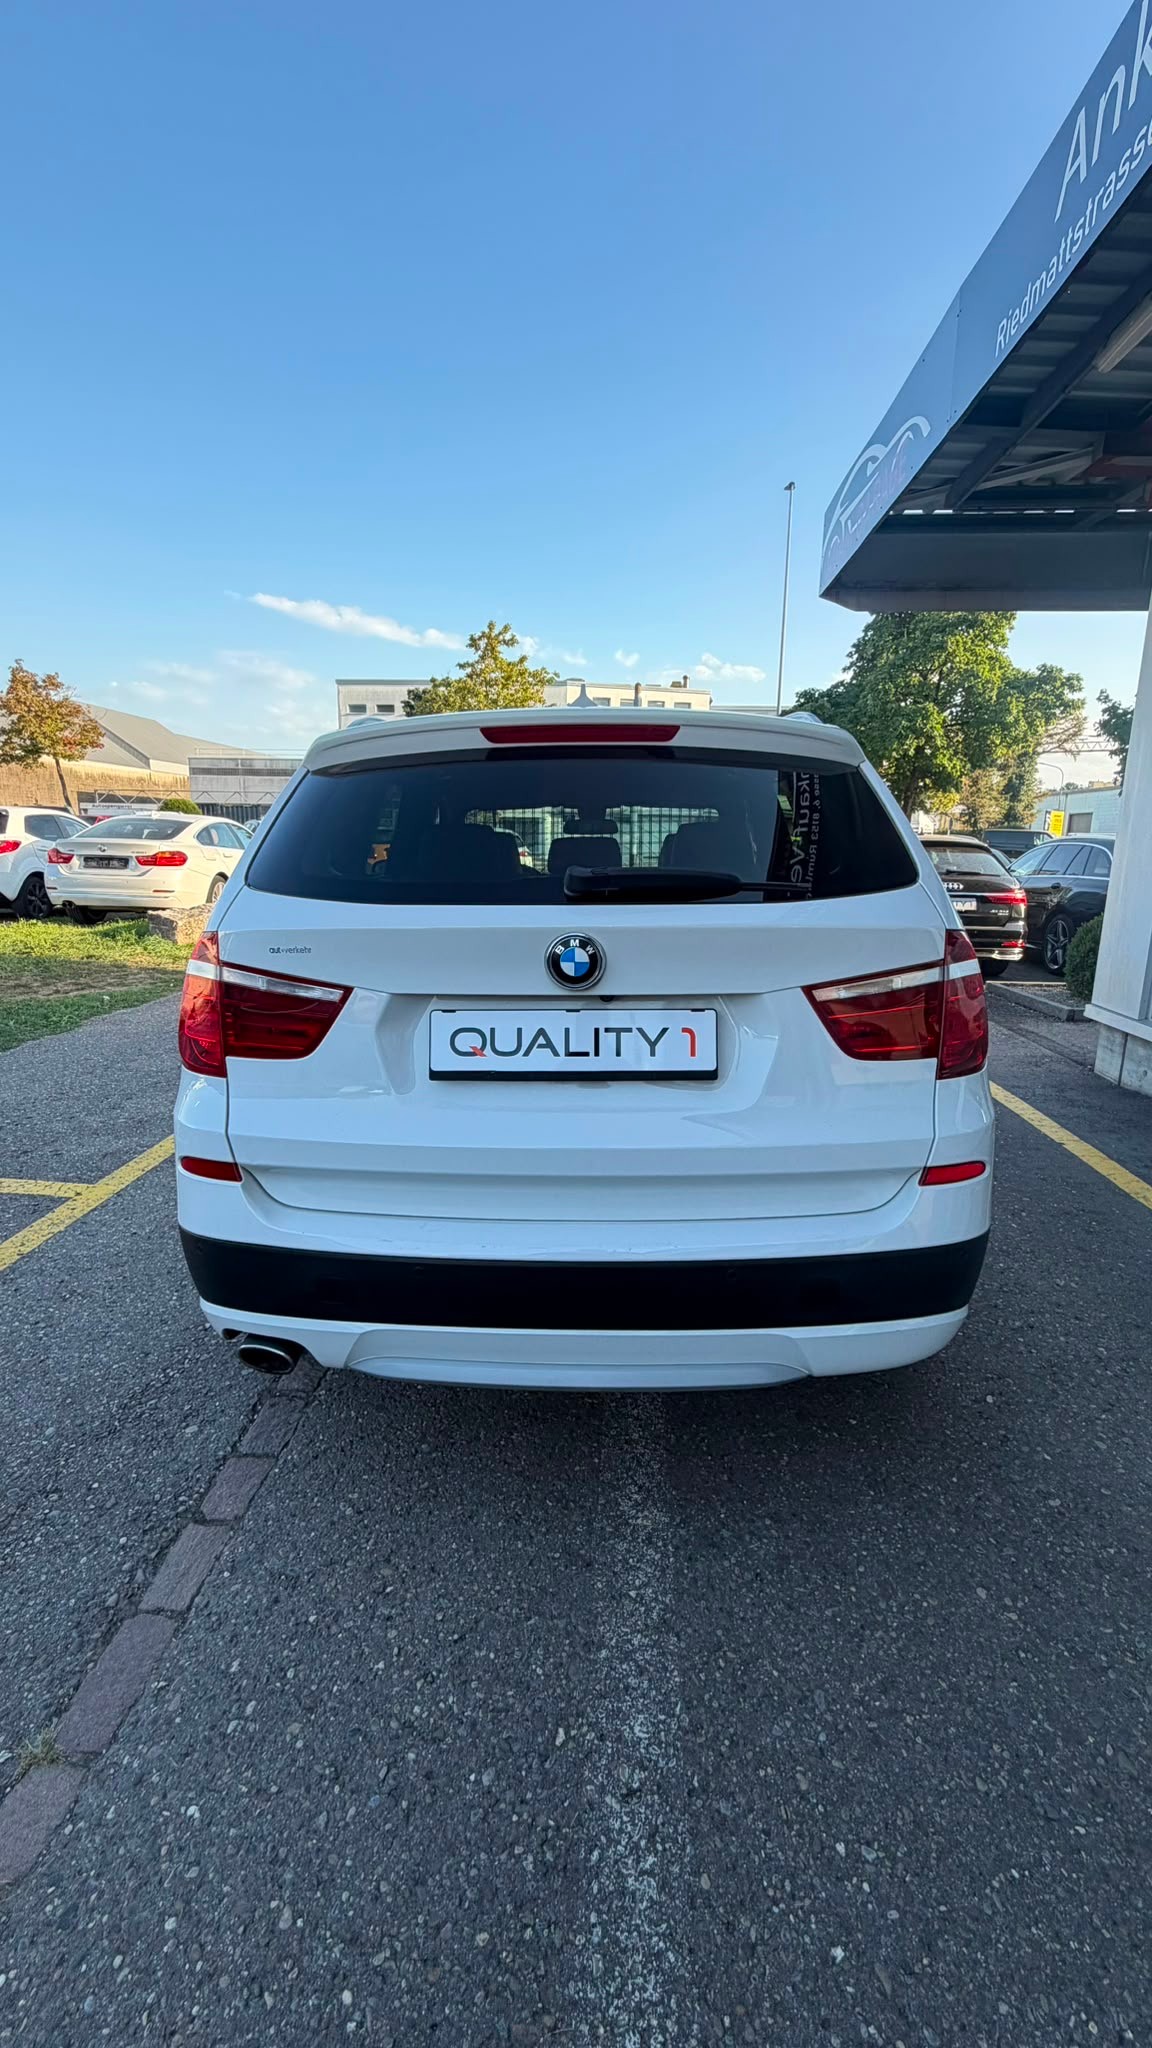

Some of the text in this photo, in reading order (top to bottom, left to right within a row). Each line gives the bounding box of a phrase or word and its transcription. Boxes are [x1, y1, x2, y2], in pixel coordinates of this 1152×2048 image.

[554, 938, 596, 955] BMW
[449, 1026, 697, 1058] QUALITY 1
